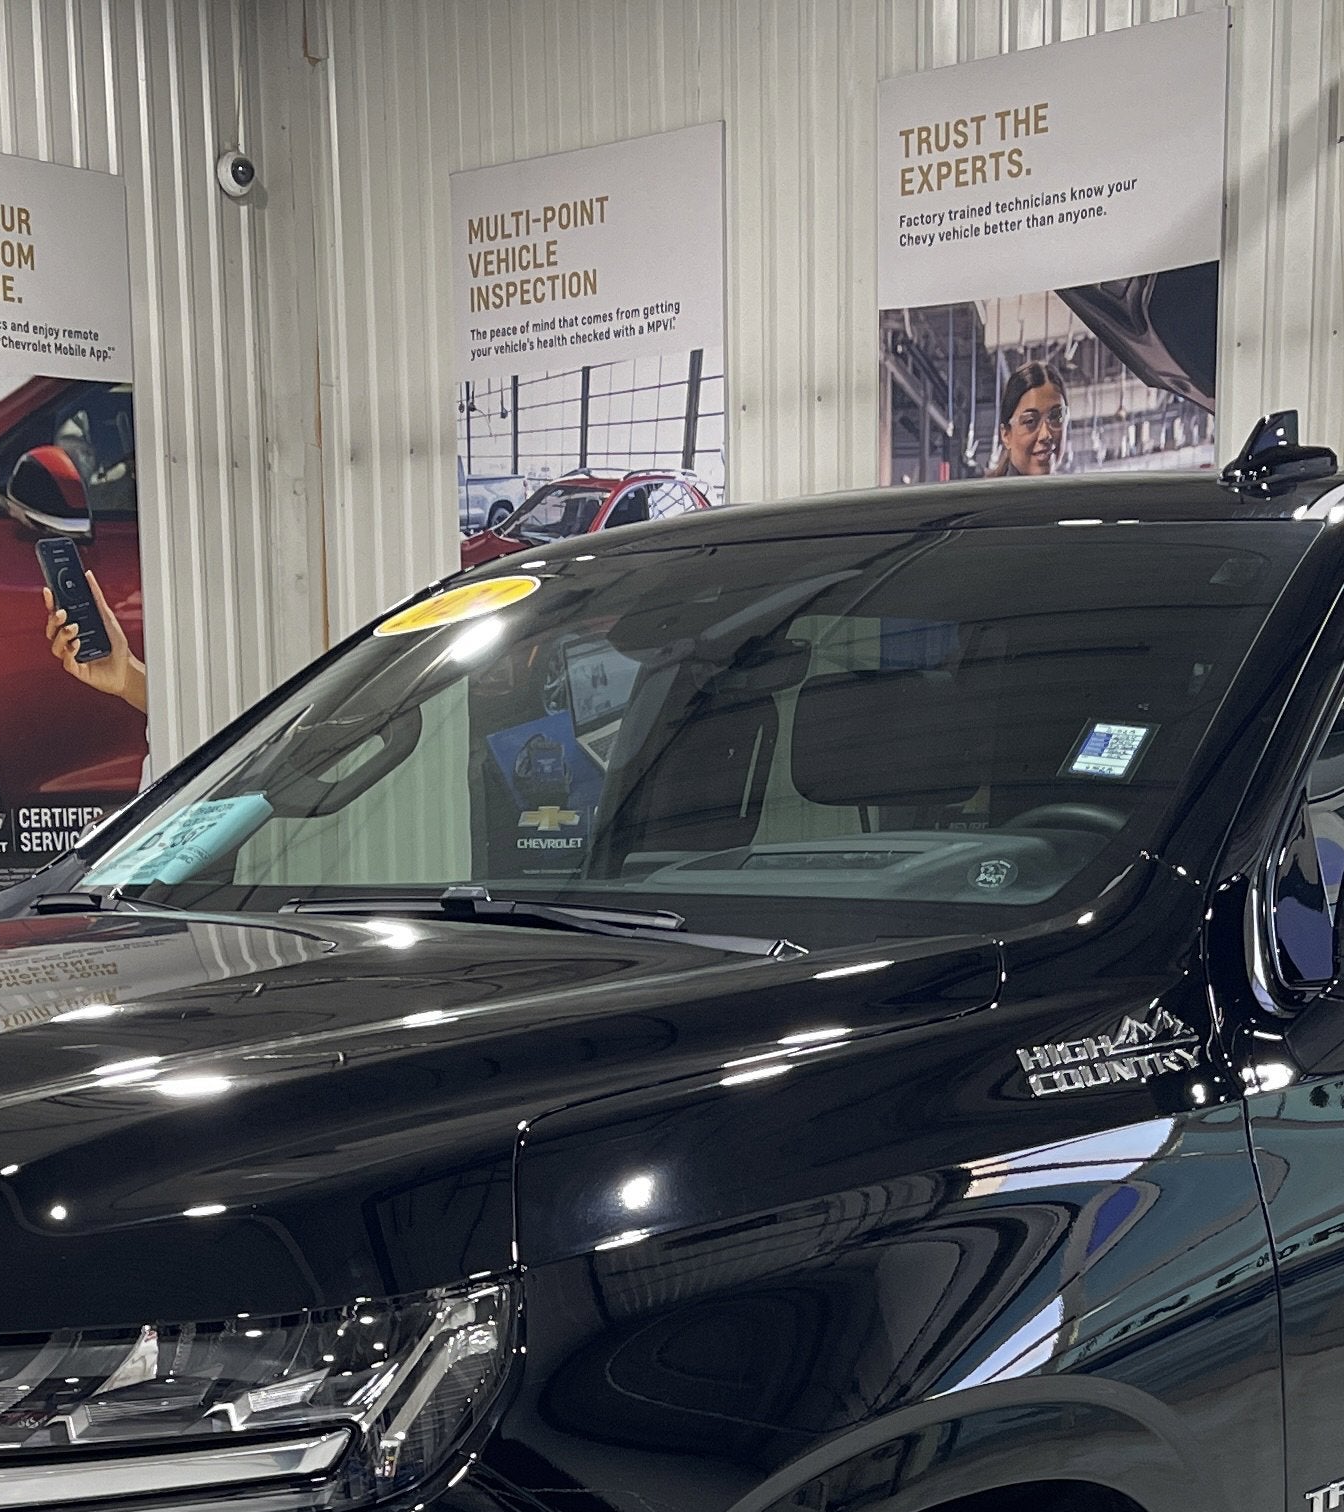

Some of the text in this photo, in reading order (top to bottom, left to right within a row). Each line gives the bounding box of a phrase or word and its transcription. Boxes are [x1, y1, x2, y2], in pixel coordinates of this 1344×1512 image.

[899, 102, 1049, 158] TRUST THE
[900, 148, 1032, 196] EXPERTS.
[468, 195, 609, 245] MULTI-POINT
[899, 178, 1138, 229] Factory trained technicians know your
[899, 205, 1107, 248] Chevy vehicle better than anyone.
[468, 240, 558, 278] VEHICLE
[470, 268, 597, 313] INSPECTION
[10, 319, 30, 334] and
[32, 322, 60, 340] enjoy
[62, 326, 99, 342] remote
[470, 301, 680, 342] The peace of mind that comes from getting
[54, 342, 87, 358] Mobile
[470, 346, 491, 361] your
[536, 334, 568, 350] health
[570, 328, 610, 346] checked
[613, 324, 635, 340] with
[638, 325, 644, 335] a
[19, 830, 81, 853] SERVIC
[516, 837, 584, 849] CHEVROLET
[1016, 1034, 1115, 1073] HIGH
[1026, 1045, 1202, 1097] COUNTRY
